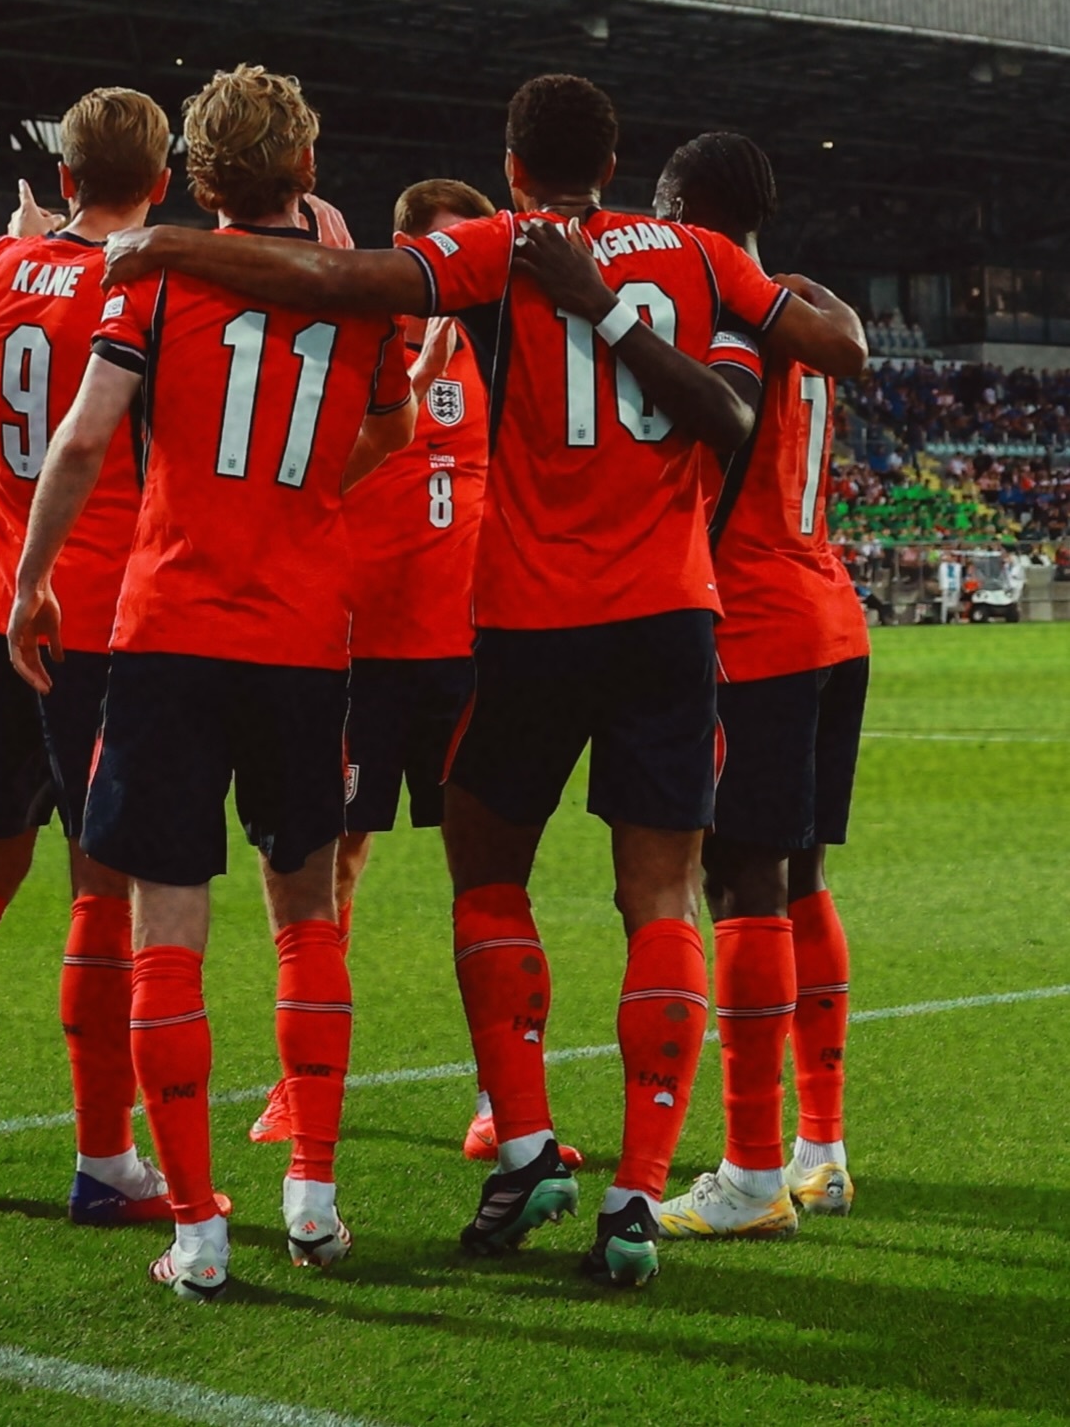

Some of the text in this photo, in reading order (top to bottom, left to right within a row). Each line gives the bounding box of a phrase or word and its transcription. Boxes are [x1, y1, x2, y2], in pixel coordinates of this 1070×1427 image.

[11, 259, 85, 298] KANE
[1, 323, 52, 480] 9
[214, 309, 338, 489] 11
[428, 470, 453, 529] 8
[820, 1046, 844, 1062] EN
[161, 1082, 197, 1104] ENG
[638, 1071, 678, 1092] ENG
